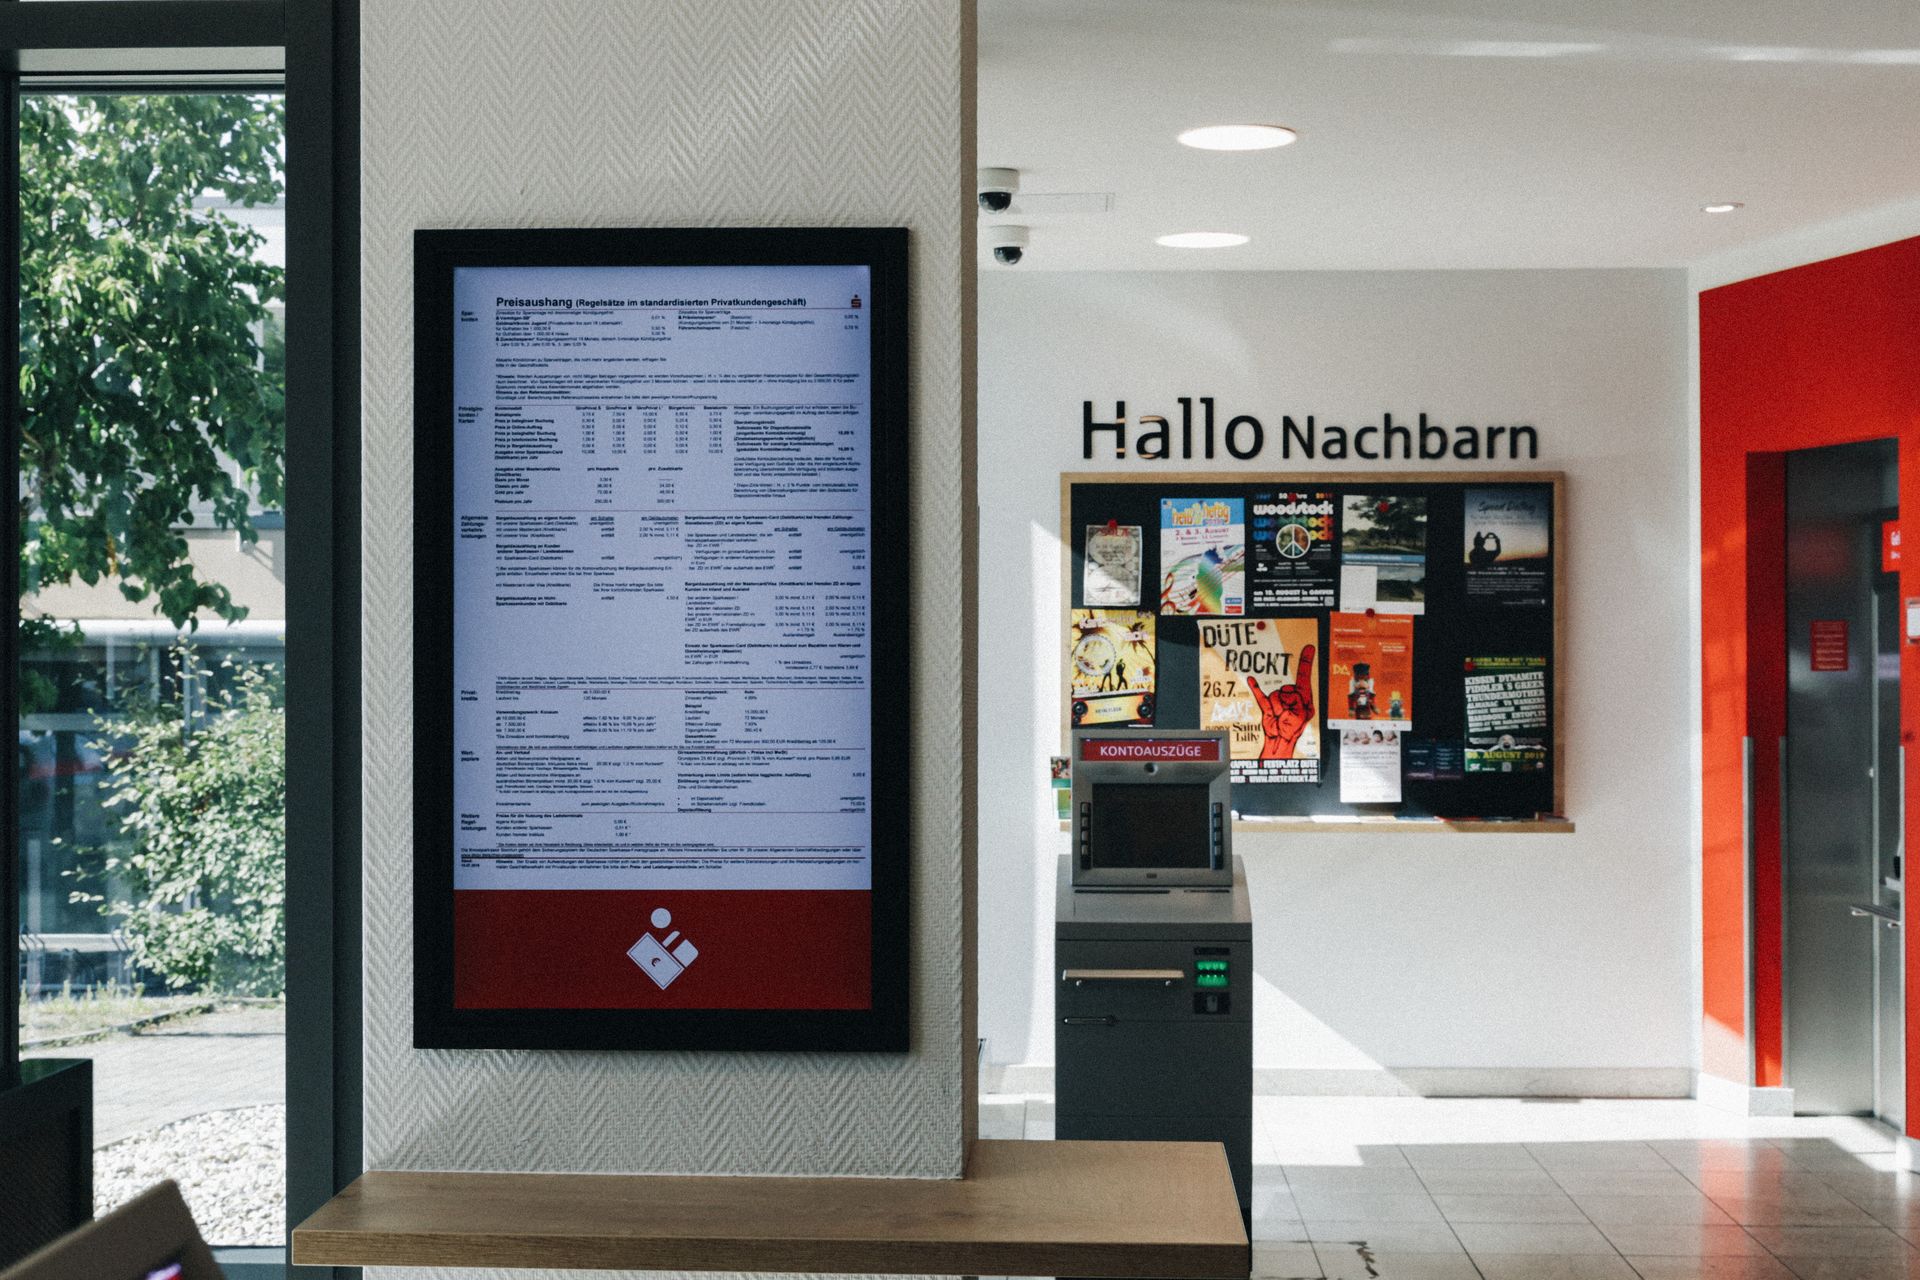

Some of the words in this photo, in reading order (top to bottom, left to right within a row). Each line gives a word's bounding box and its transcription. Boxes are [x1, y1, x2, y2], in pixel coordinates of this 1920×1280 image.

[496, 297, 572, 307] Preisaushang
[576, 299, 626, 308] (Regelsätze
[711, 298, 807, 309] Privatkundengeschäft)
[1083, 397, 1264, 459] Hallo
[1282, 412, 1538, 459] Nachbarn
[1253, 500, 1333, 515] woodstock
[1203, 622, 1257, 648] DÜTE
[1225, 649, 1293, 676] ROCKT
[1499, 672, 1544, 682] DYNAMITE
[1203, 681, 1236, 697] 26.7.
[1100, 745, 1201, 757] KONTOAUSZÜGE
